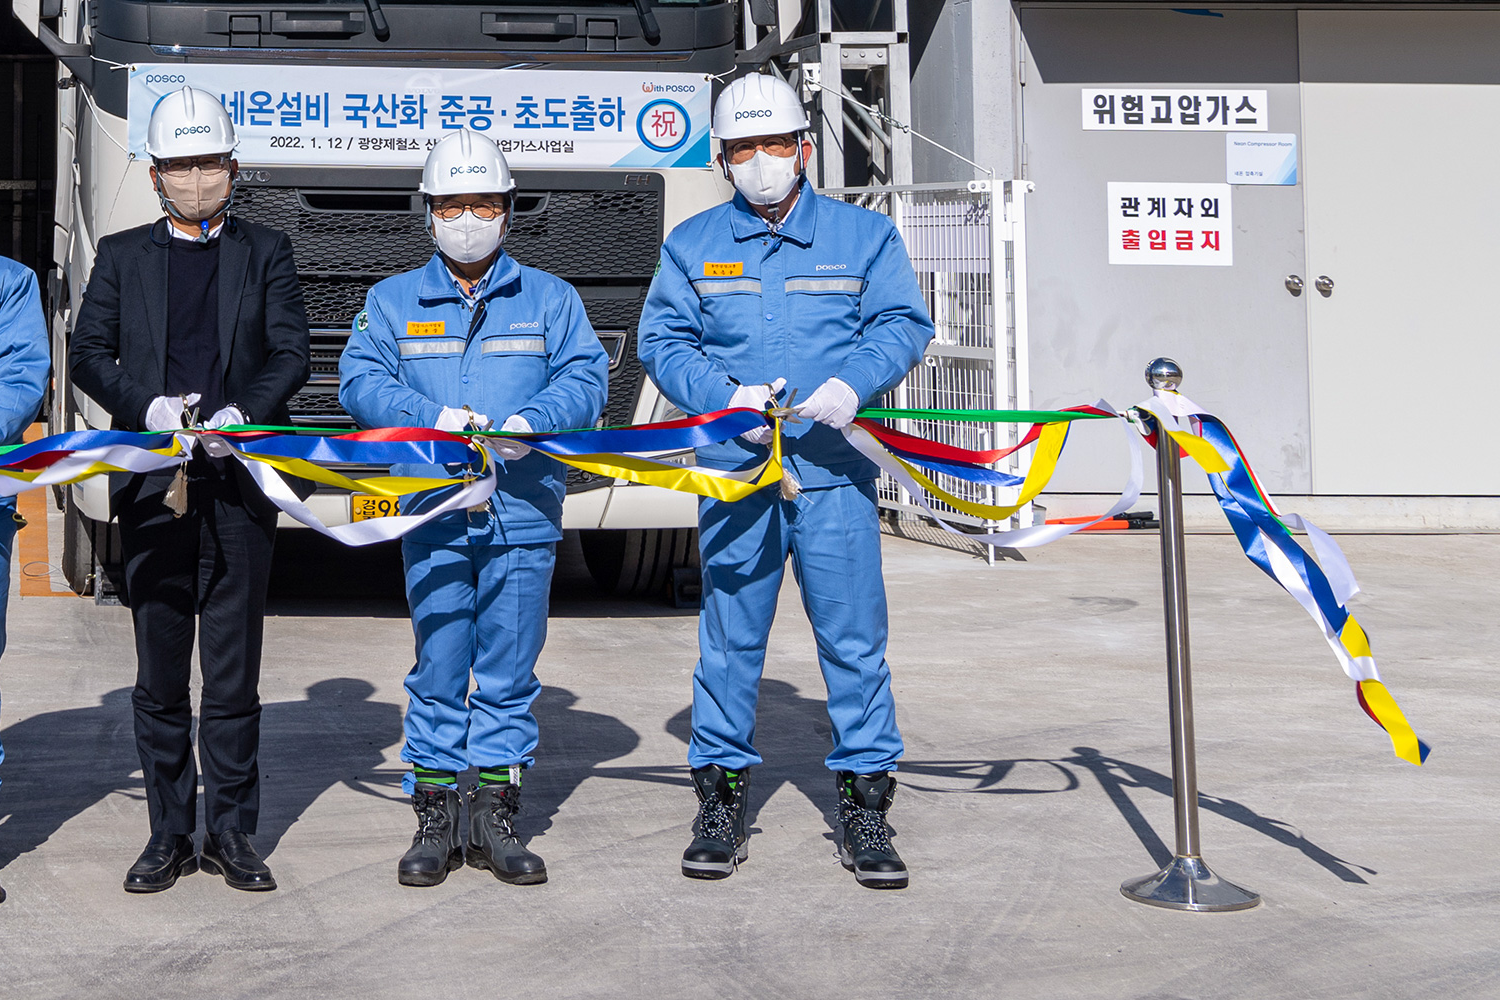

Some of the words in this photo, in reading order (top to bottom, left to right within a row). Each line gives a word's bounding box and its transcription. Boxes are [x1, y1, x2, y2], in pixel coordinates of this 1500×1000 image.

[145, 74, 186, 85] posco
[641, 81, 664, 93] With
[665, 85, 695, 93] POSCO
[220, 90, 330, 129] 네온설비
[343, 94, 427, 129] 국산화
[734, 109, 773, 122] posco
[1093, 95, 1257, 125] 위험고압가스
[651, 109, 678, 138] 祝
[174, 124, 211, 139] posco
[270, 136, 304, 148] 2022.
[311, 137, 321, 149] 1.
[328, 138, 342, 148] 12
[358, 138, 420, 150] 광양제철소
[1122, 230, 1219, 251] 출입금지
[815, 263, 847, 272] posco
[509, 321, 539, 331] posco
